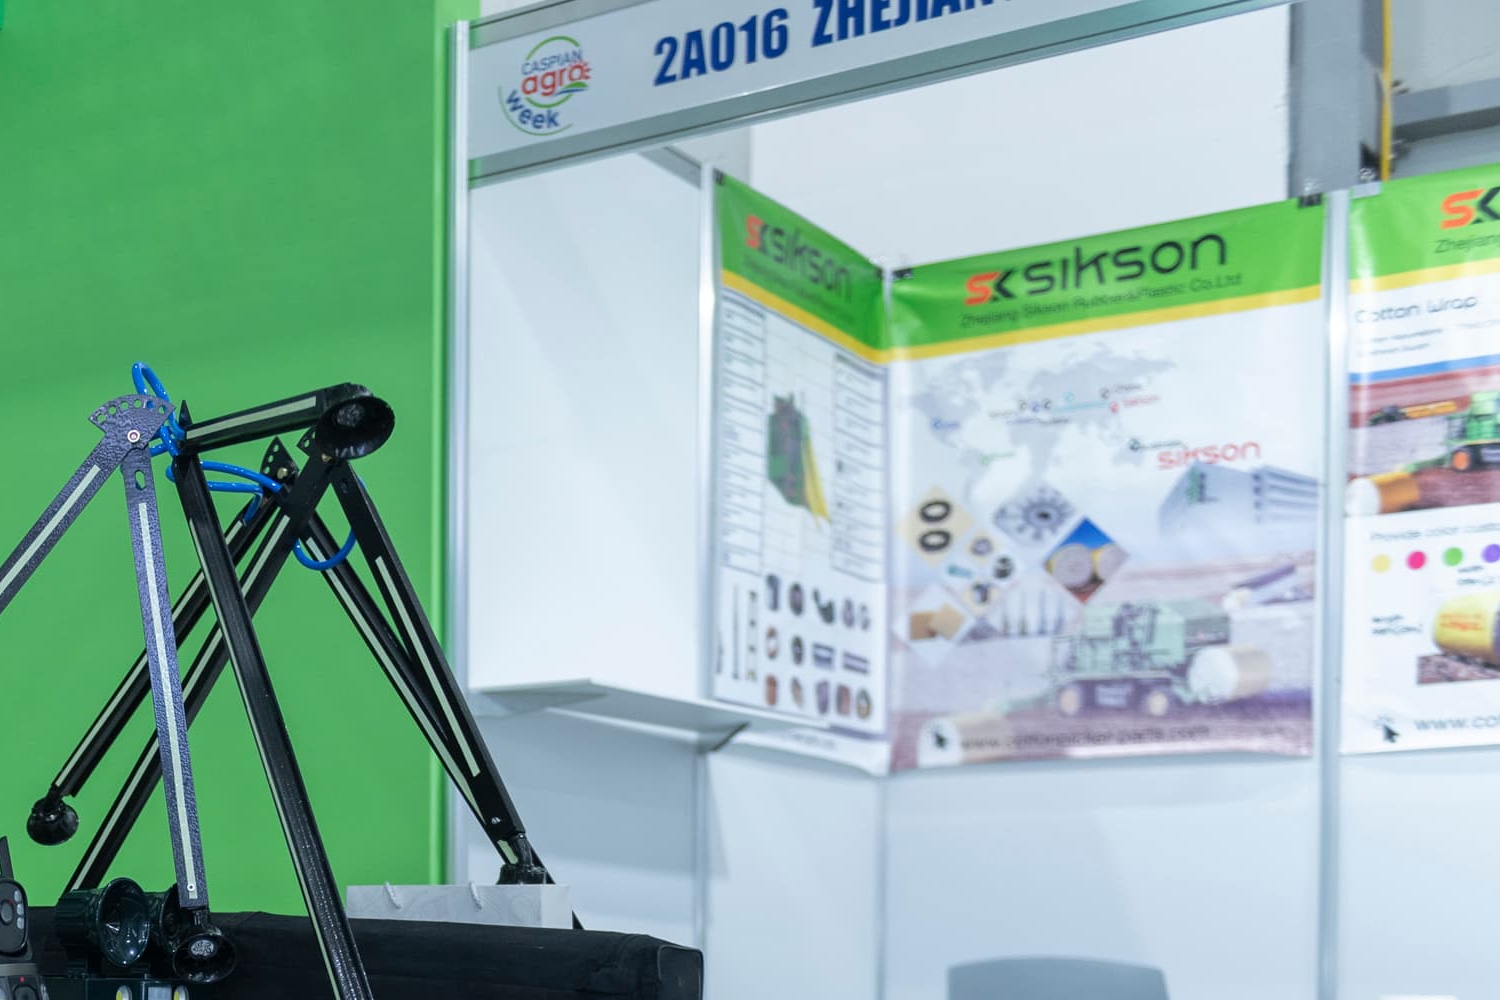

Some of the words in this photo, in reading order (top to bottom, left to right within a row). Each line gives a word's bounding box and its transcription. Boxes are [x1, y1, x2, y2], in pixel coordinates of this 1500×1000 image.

[653, 8, 790, 86] 2A016
[811, 0, 997, 48] ZHEJ
[521, 49, 583, 76] CASPIAN
[521, 62, 587, 97] agro
[505, 90, 561, 129] week
